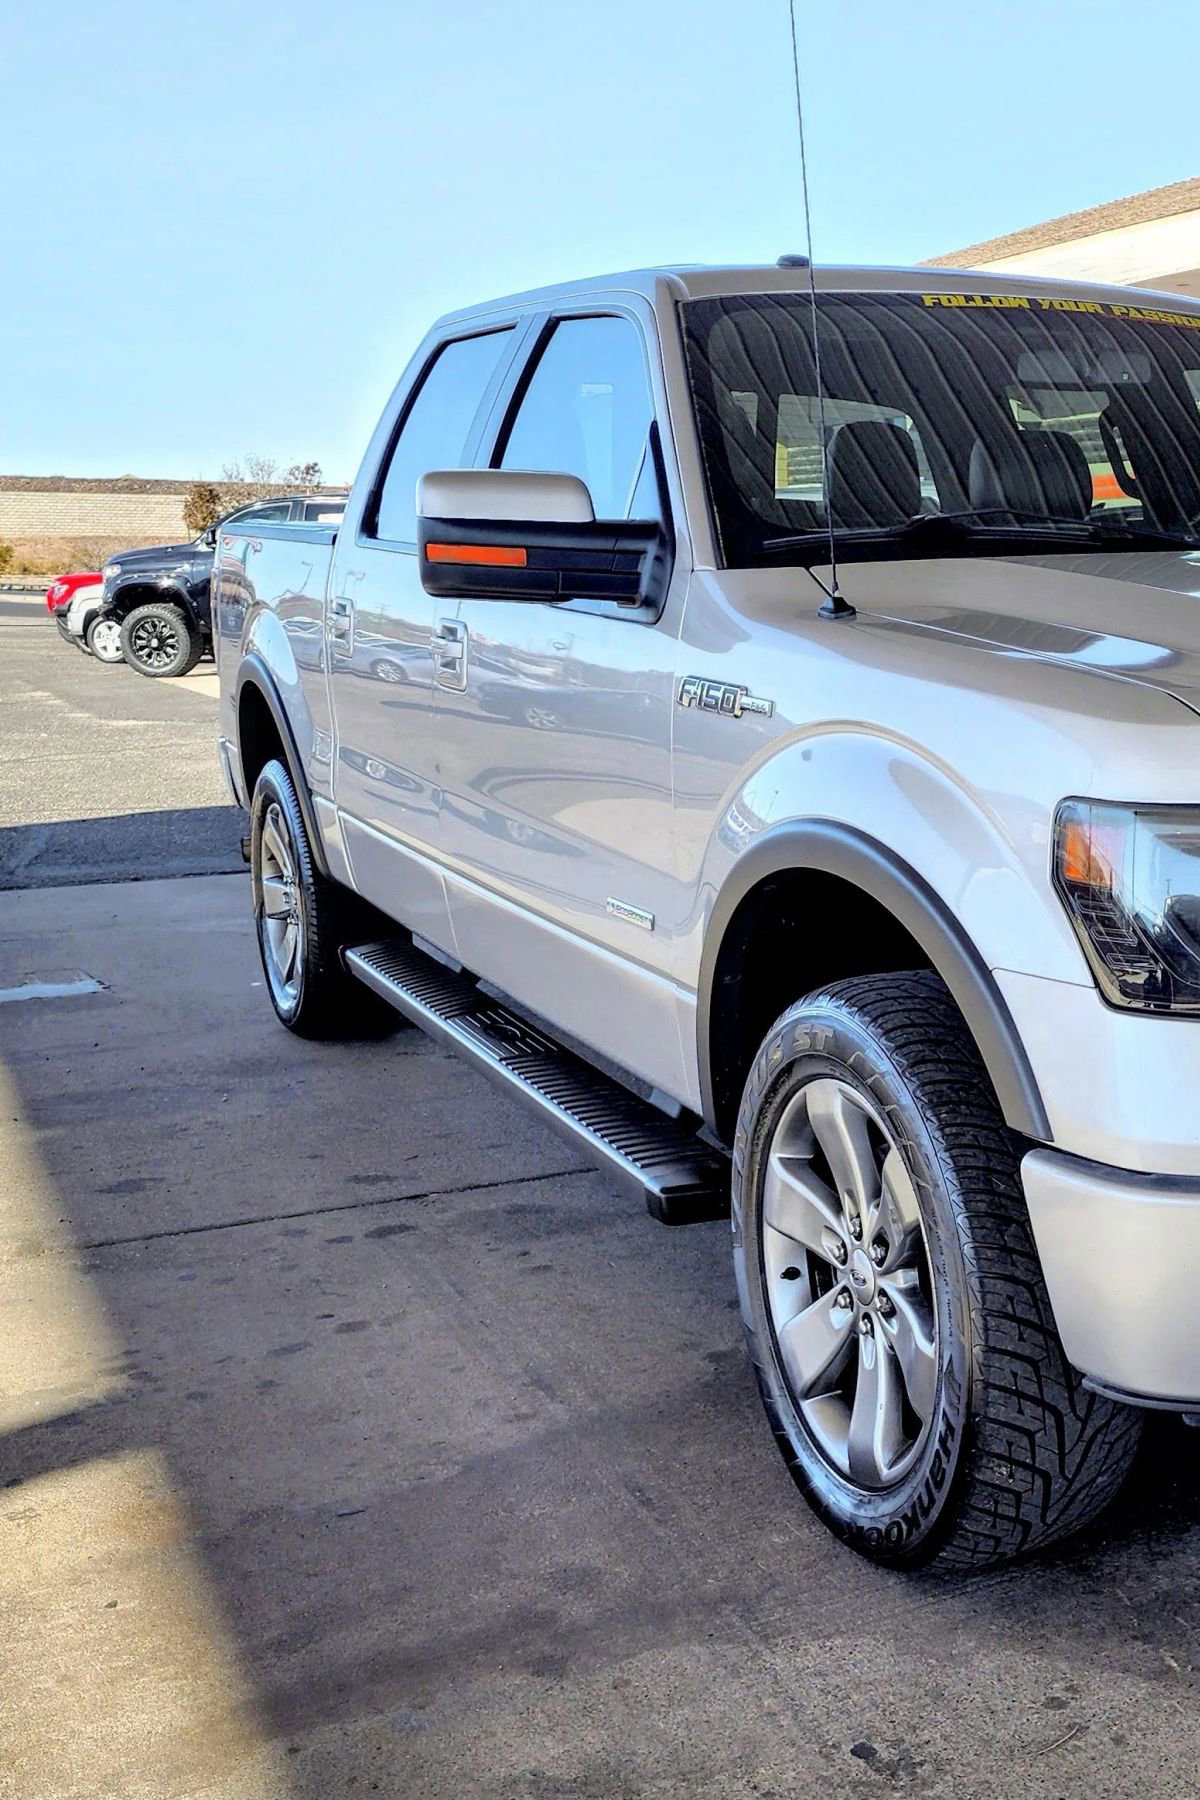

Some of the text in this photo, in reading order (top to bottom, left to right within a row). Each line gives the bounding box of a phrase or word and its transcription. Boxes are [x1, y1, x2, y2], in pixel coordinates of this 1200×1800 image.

[922, 294, 1032, 309] FOLLOW
[1036, 298, 1104, 315] YOUR
[792, 1023, 834, 1051] ST
